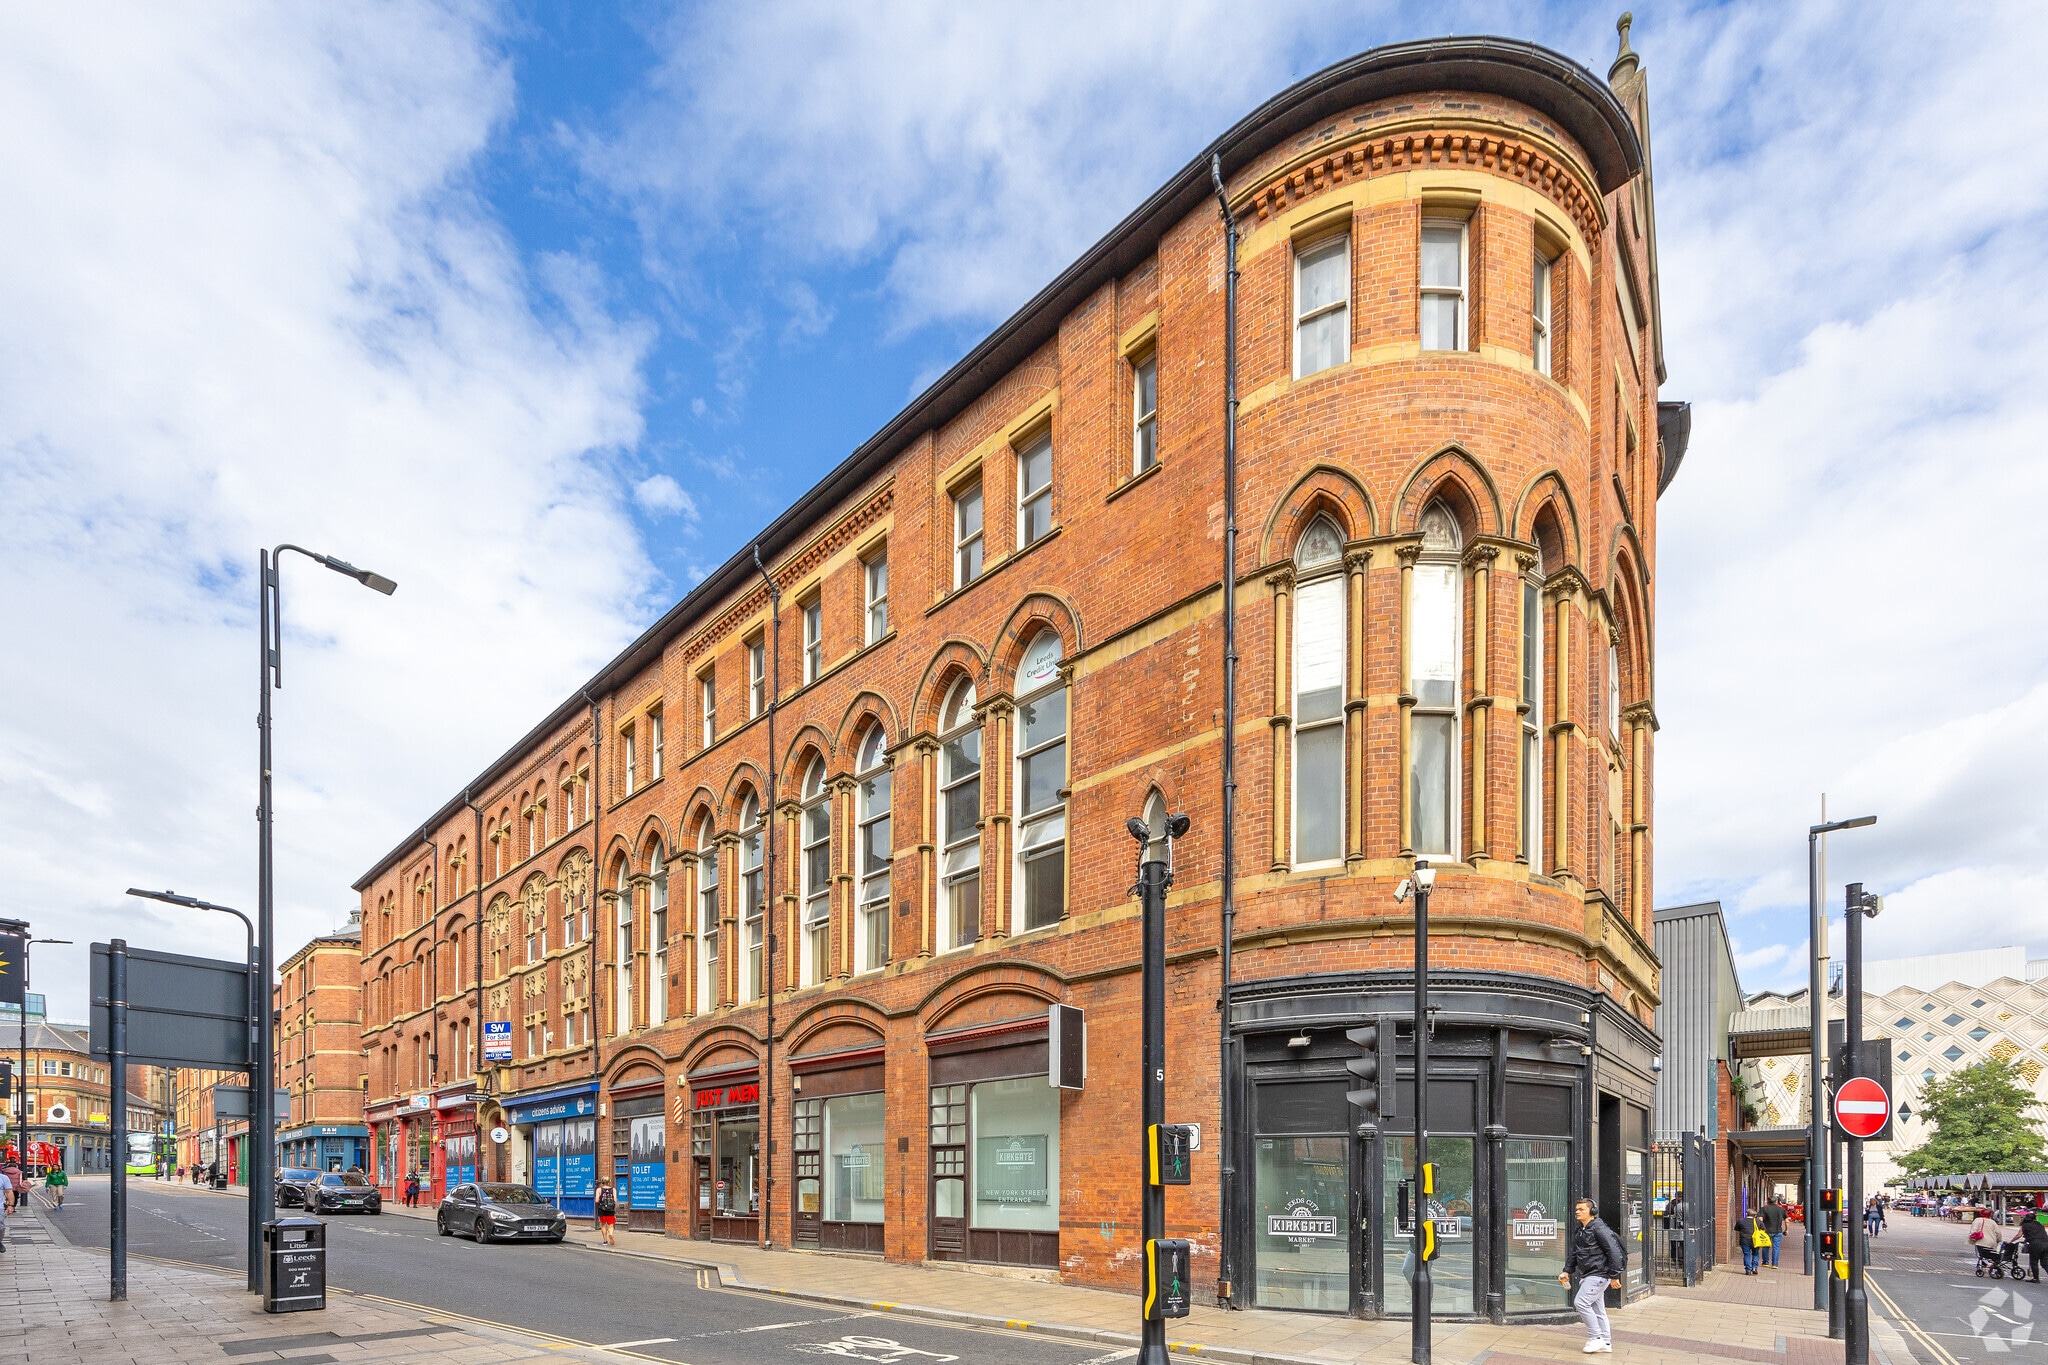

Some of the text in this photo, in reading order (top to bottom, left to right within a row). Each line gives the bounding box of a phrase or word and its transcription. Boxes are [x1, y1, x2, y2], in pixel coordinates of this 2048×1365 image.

[1036, 652, 1054, 665] Leeds
[1026, 664, 1046, 678] Credit
[490, 1023, 505, 1033] SW
[1156, 1069, 1164, 1081] 5
[695, 1083, 759, 1110] JUST MEN
[531, 1104, 566, 1118] citizens advice
[543, 1159, 551, 1167] LET
[566, 1157, 581, 1166] TO LET
[999, 1152, 1033, 1162] KIRKGATE
[632, 1165, 651, 1174] TO LET
[1284, 1197, 1320, 1212] LEEDS CITY
[1523, 1200, 1547, 1214] LEEDS CITY
[1273, 1219, 1332, 1232] KIRKGATE
[1516, 1223, 1554, 1235] KIRKGATE
[289, 1241, 309, 1249] Litter
